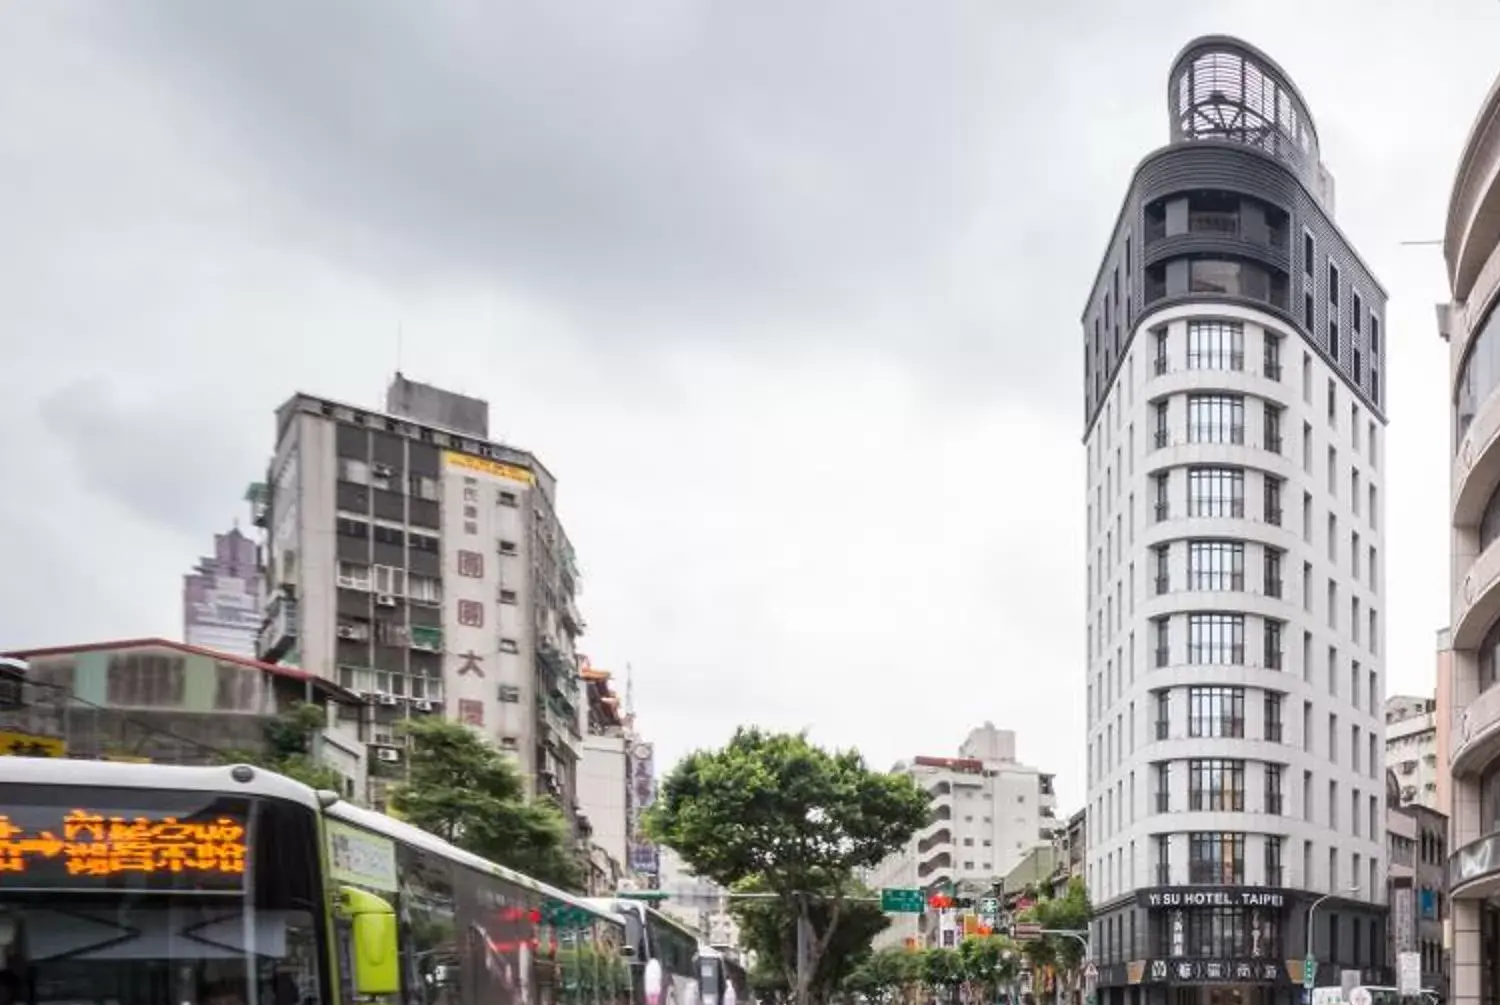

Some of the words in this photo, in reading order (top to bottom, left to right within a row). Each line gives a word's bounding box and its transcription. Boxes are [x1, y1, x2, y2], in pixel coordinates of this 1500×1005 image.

[1163, 893, 1181, 905] SU
[1184, 892, 1233, 905] HOTEL
[1242, 893, 1283, 906] TAIPEI
